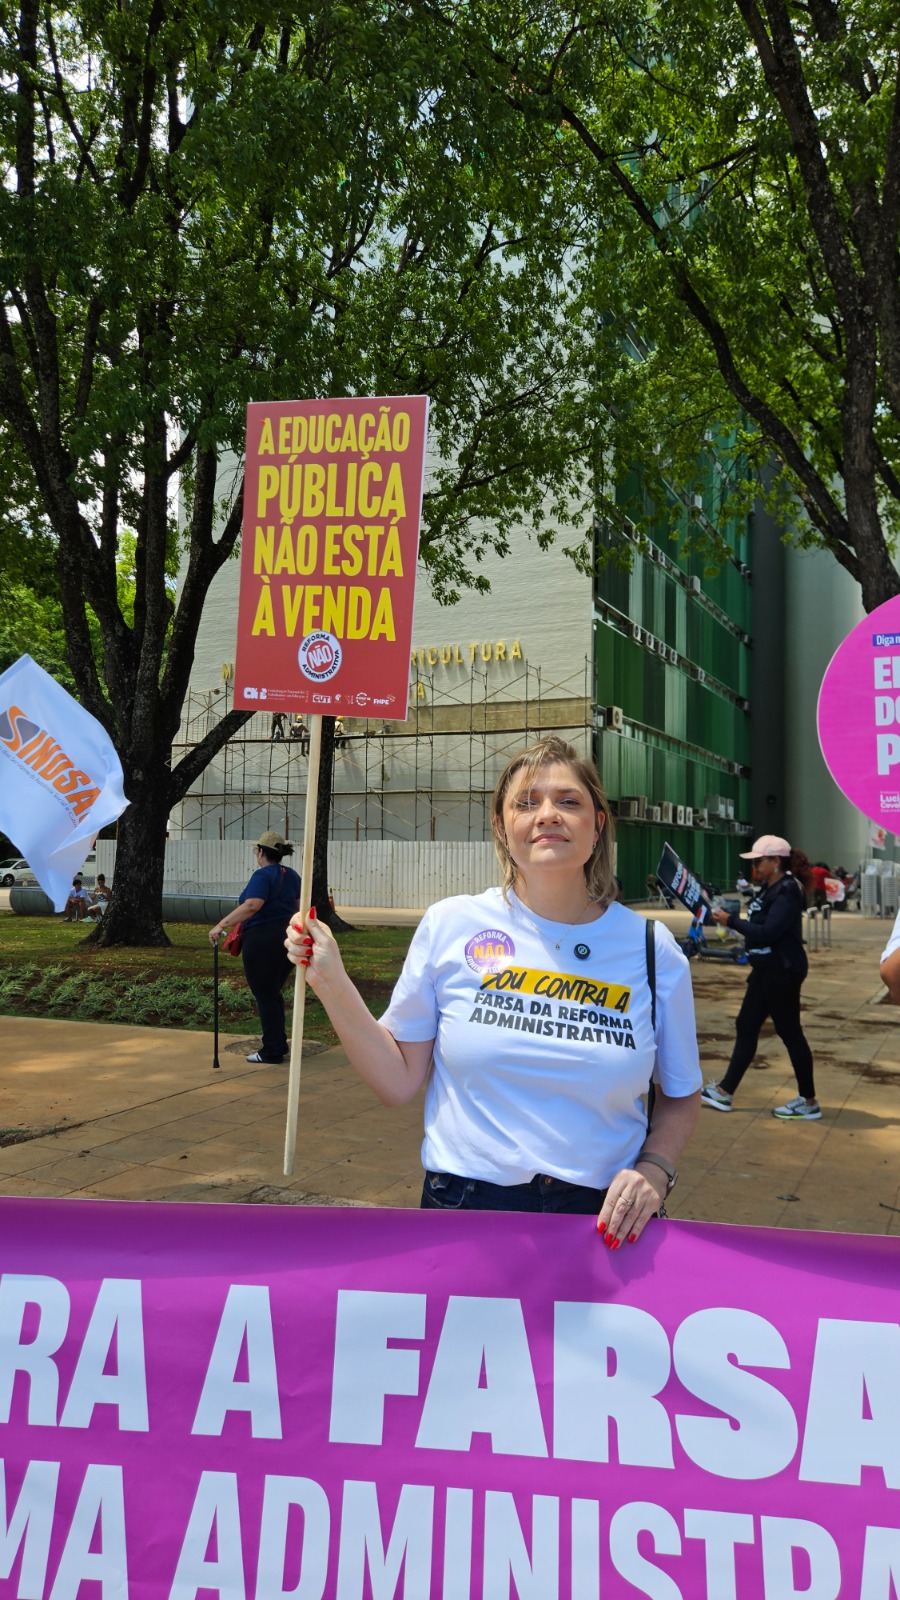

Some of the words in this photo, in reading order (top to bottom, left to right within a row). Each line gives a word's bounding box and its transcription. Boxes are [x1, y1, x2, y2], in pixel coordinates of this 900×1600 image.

[258, 417, 275, 455] A
[279, 406, 411, 460] EDUCAÇÃO
[257, 455, 407, 518] PÚBLICA
[253, 517, 318, 575] NÃO
[324, 515, 404, 577] ESTÁ
[251, 575, 276, 637] À
[282, 585, 397, 642] VENDA
[302, 633, 330, 652] REFORMA
[308, 645, 333, 669] NÃO
[410, 640, 522, 667] RICULTURA
[876, 634, 894, 647] Diga
[302, 650, 340, 680] ADMINISTRATIVA
[874, 655, 900, 690] E
[875, 695, 900, 727] D
[0, 705, 101, 824] SINDSA
[473, 942, 505, 959] NÃO
[474, 931, 507, 943] REFORMA
[473, 992, 525, 1014] FARSA
[529, 1001, 553, 1018] DA
[558, 1006, 634, 1031] REFORMA
[533, 975, 609, 1008] CONTRA
[614, 991, 631, 1014] A
[468, 1008, 637, 1050] ADMINISTRATIVA
[191, 1284, 283, 1440] A
[328, 1289, 900, 1492] FARSA
